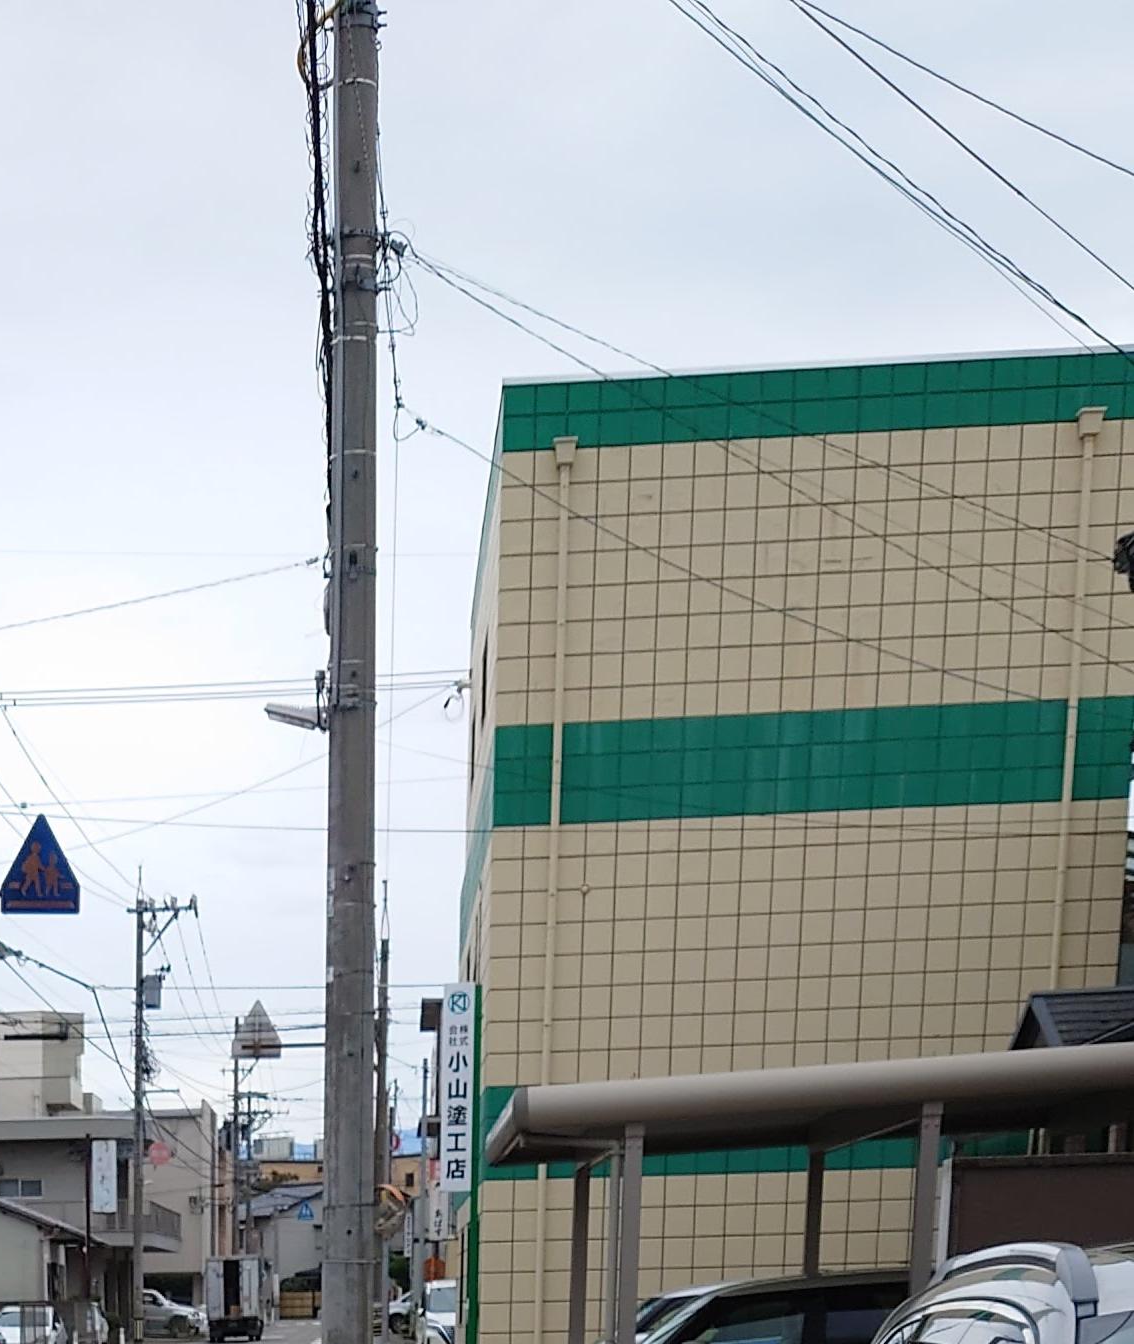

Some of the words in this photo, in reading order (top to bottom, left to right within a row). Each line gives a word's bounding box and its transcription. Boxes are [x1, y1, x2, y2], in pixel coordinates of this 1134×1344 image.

[446, 1051, 469, 1180] 小山塗工店
